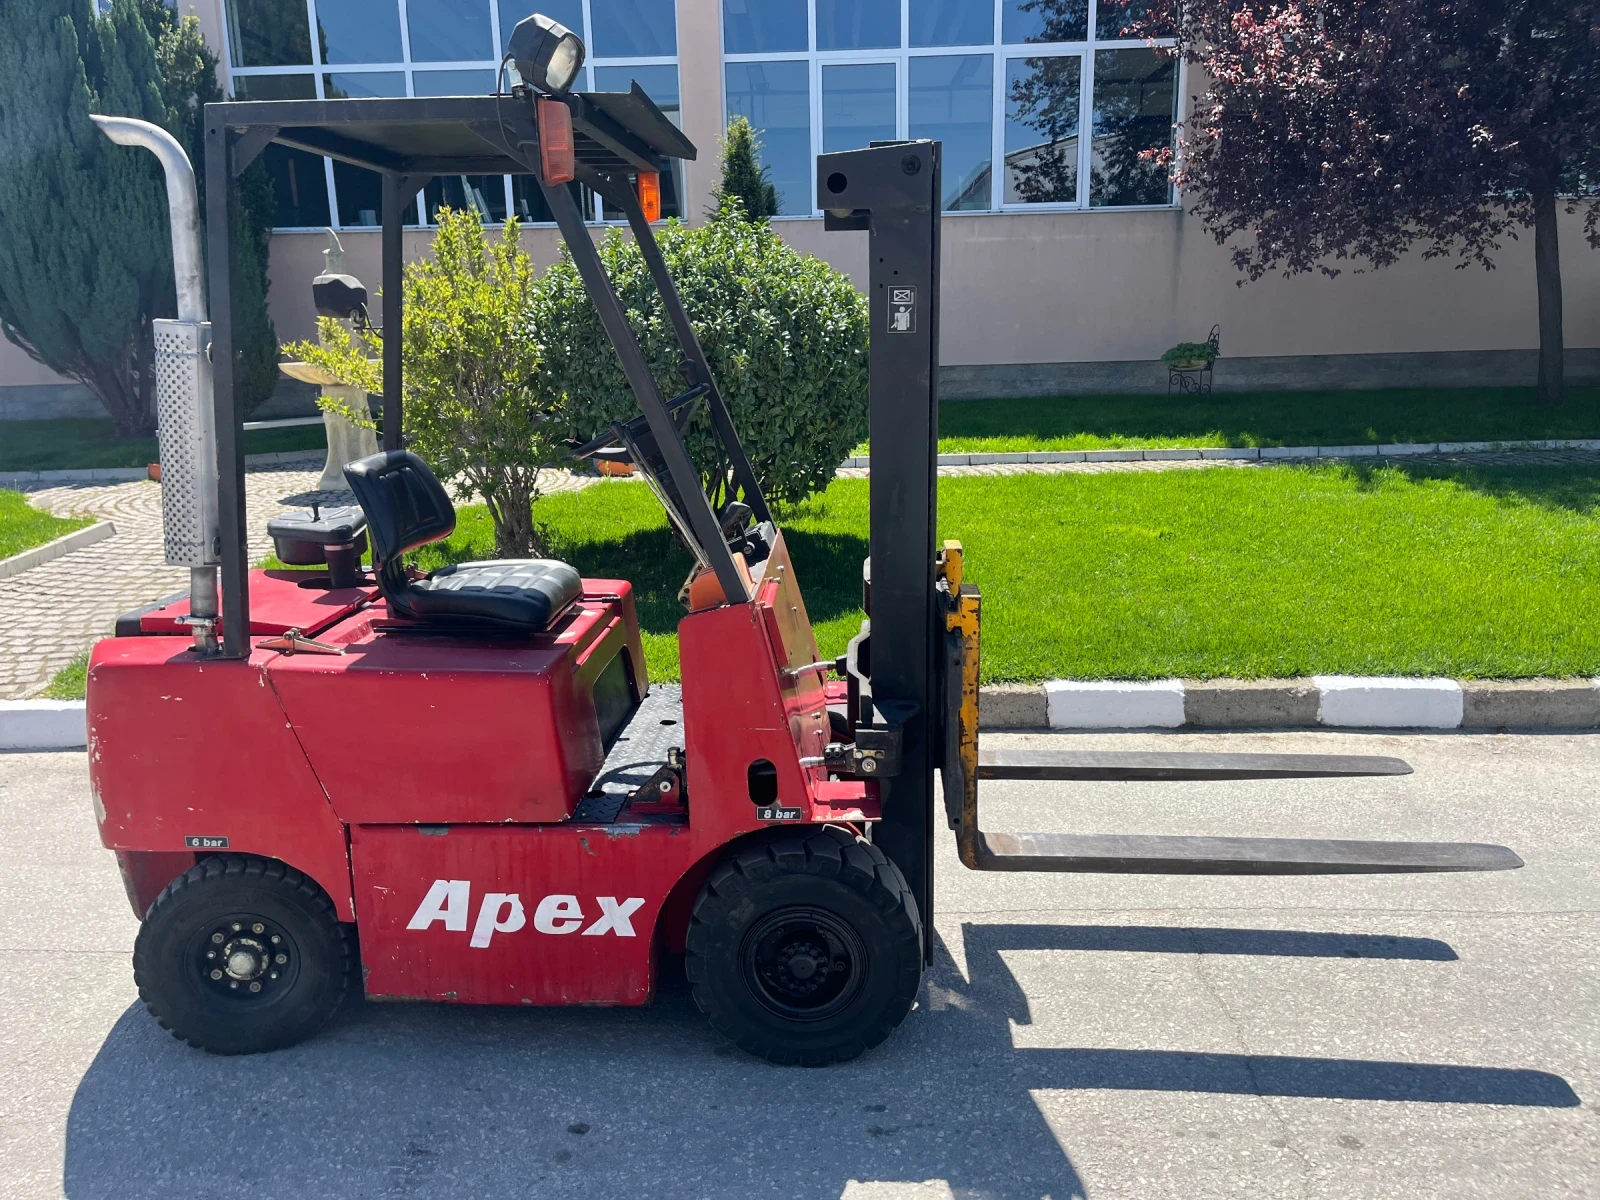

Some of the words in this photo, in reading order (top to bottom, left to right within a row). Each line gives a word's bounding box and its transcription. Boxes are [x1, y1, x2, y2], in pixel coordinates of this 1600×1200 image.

[764, 810, 771, 818] 8
[776, 810, 795, 818] bar
[192, 838, 199, 846] 6
[203, 838, 222, 847] bar
[406, 879, 646, 948] Apex
